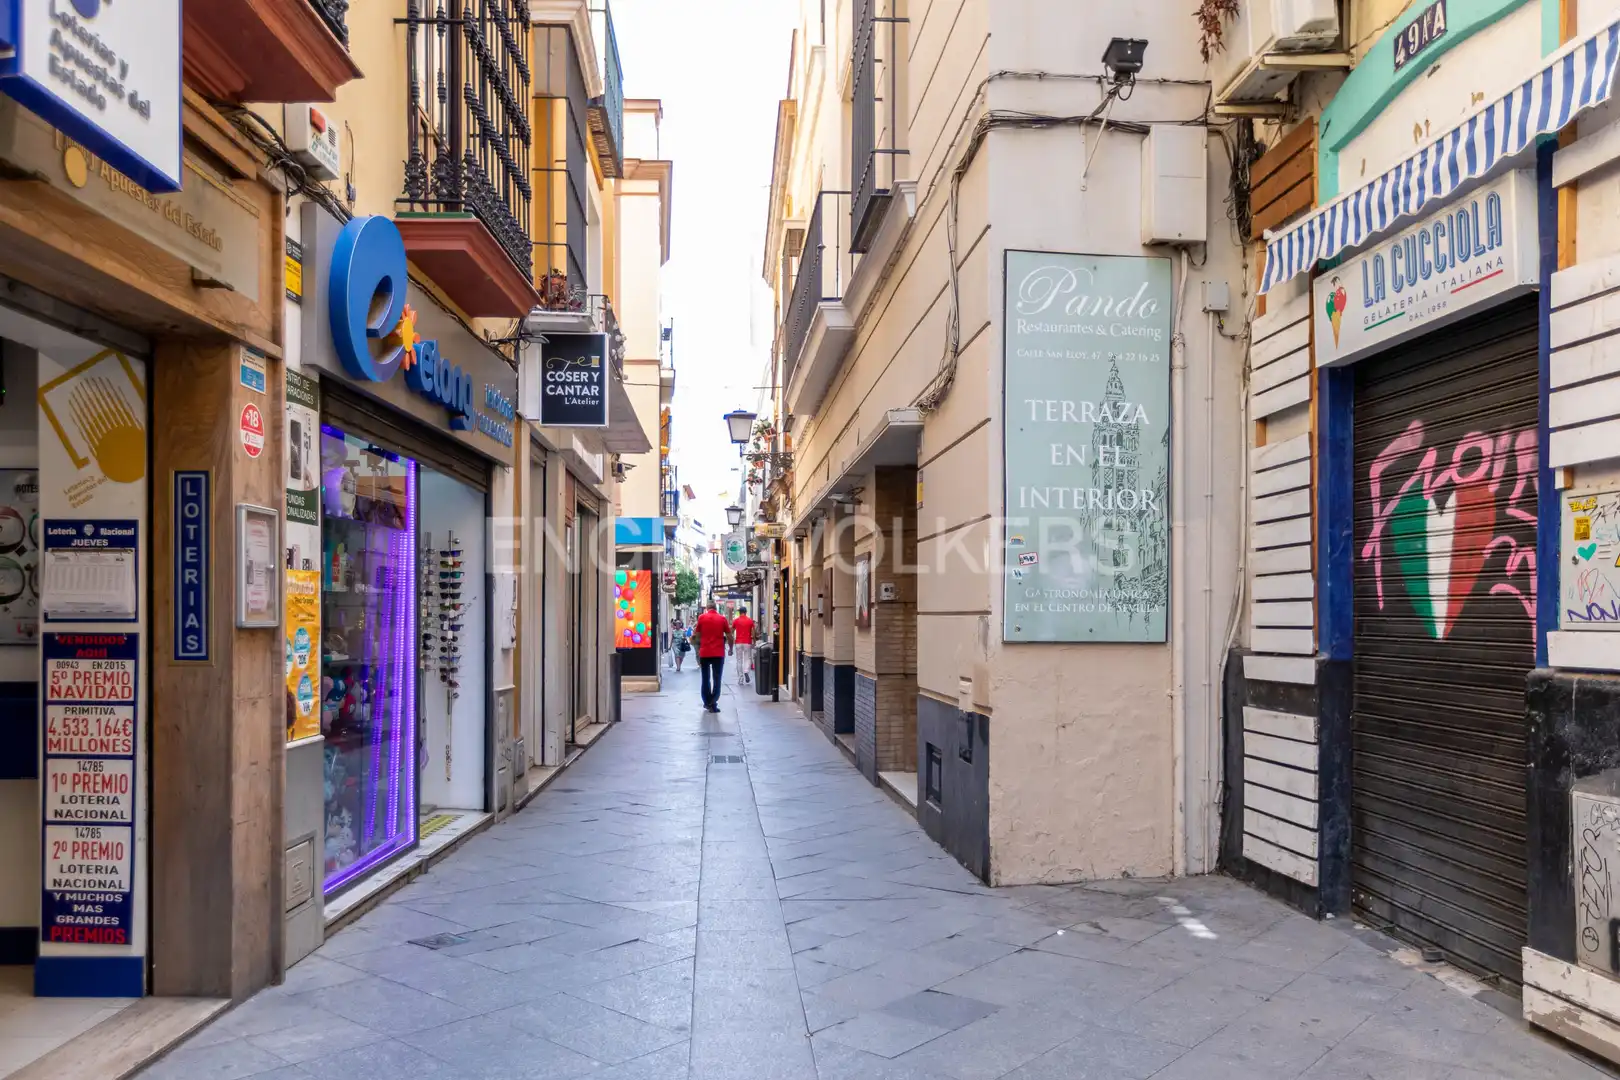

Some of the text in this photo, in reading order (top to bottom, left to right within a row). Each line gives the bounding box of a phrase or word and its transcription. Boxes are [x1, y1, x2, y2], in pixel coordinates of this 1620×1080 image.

[128, 90, 151, 121] del
[99, 161, 162, 214] Apuestas
[164, 199, 184, 229] del
[185, 212, 223, 252] Estado
[1362, 190, 1503, 308] LA CUCCIOLA
[1016, 265, 1160, 319] Pando
[1364, 256, 1504, 325] GELATERIA ITALIANA
[1017, 319, 1161, 341] Restaurantes & Catering
[546, 371, 600, 383] COSER Y
[420, 339, 475, 431] etong
[546, 384, 600, 396] CANTAR
[564, 397, 600, 405] L'Atelier
[1025, 399, 1150, 425] TERRAZA
[1051, 444, 1127, 467] EN EL
[1019, 486, 1160, 511] INTERIOR
[48, 527, 135, 536] Lotería Nacional
[71, 538, 109, 547] JUEVES
[184, 480, 200, 651] LOTERIAS
[1015, 603, 1030, 613] EN
[1034, 603, 1045, 613] EL
[1048, 603, 1095, 613] CENTRO
[1098, 603, 1113, 613] DE
[57, 635, 125, 645] VENDIDOS
[56, 661, 126, 670] 00943 EN 2015
[72, 671, 131, 686] PREMIO
[49, 685, 132, 699] NAVIDAD
[64, 706, 116, 716] PRIMITIVA
[48, 717, 132, 737] 4.533.164€
[48, 738, 132, 753] MILLONES
[77, 761, 104, 773] 14785
[72, 773, 129, 794] PREMIO
[61, 795, 121, 805] LOTERIA
[54, 809, 128, 820] NACIONAL
[75, 827, 102, 839] 14785
[71, 841, 124, 861] PREMIO
[60, 864, 119, 875] LOTERIA
[52, 878, 125, 889] NACIONAL
[53, 892, 123, 903] Y MUCHOS
[73, 904, 104, 913] MAS
[56, 915, 120, 926] GRANDES
[51, 926, 126, 944] PREMIOS
